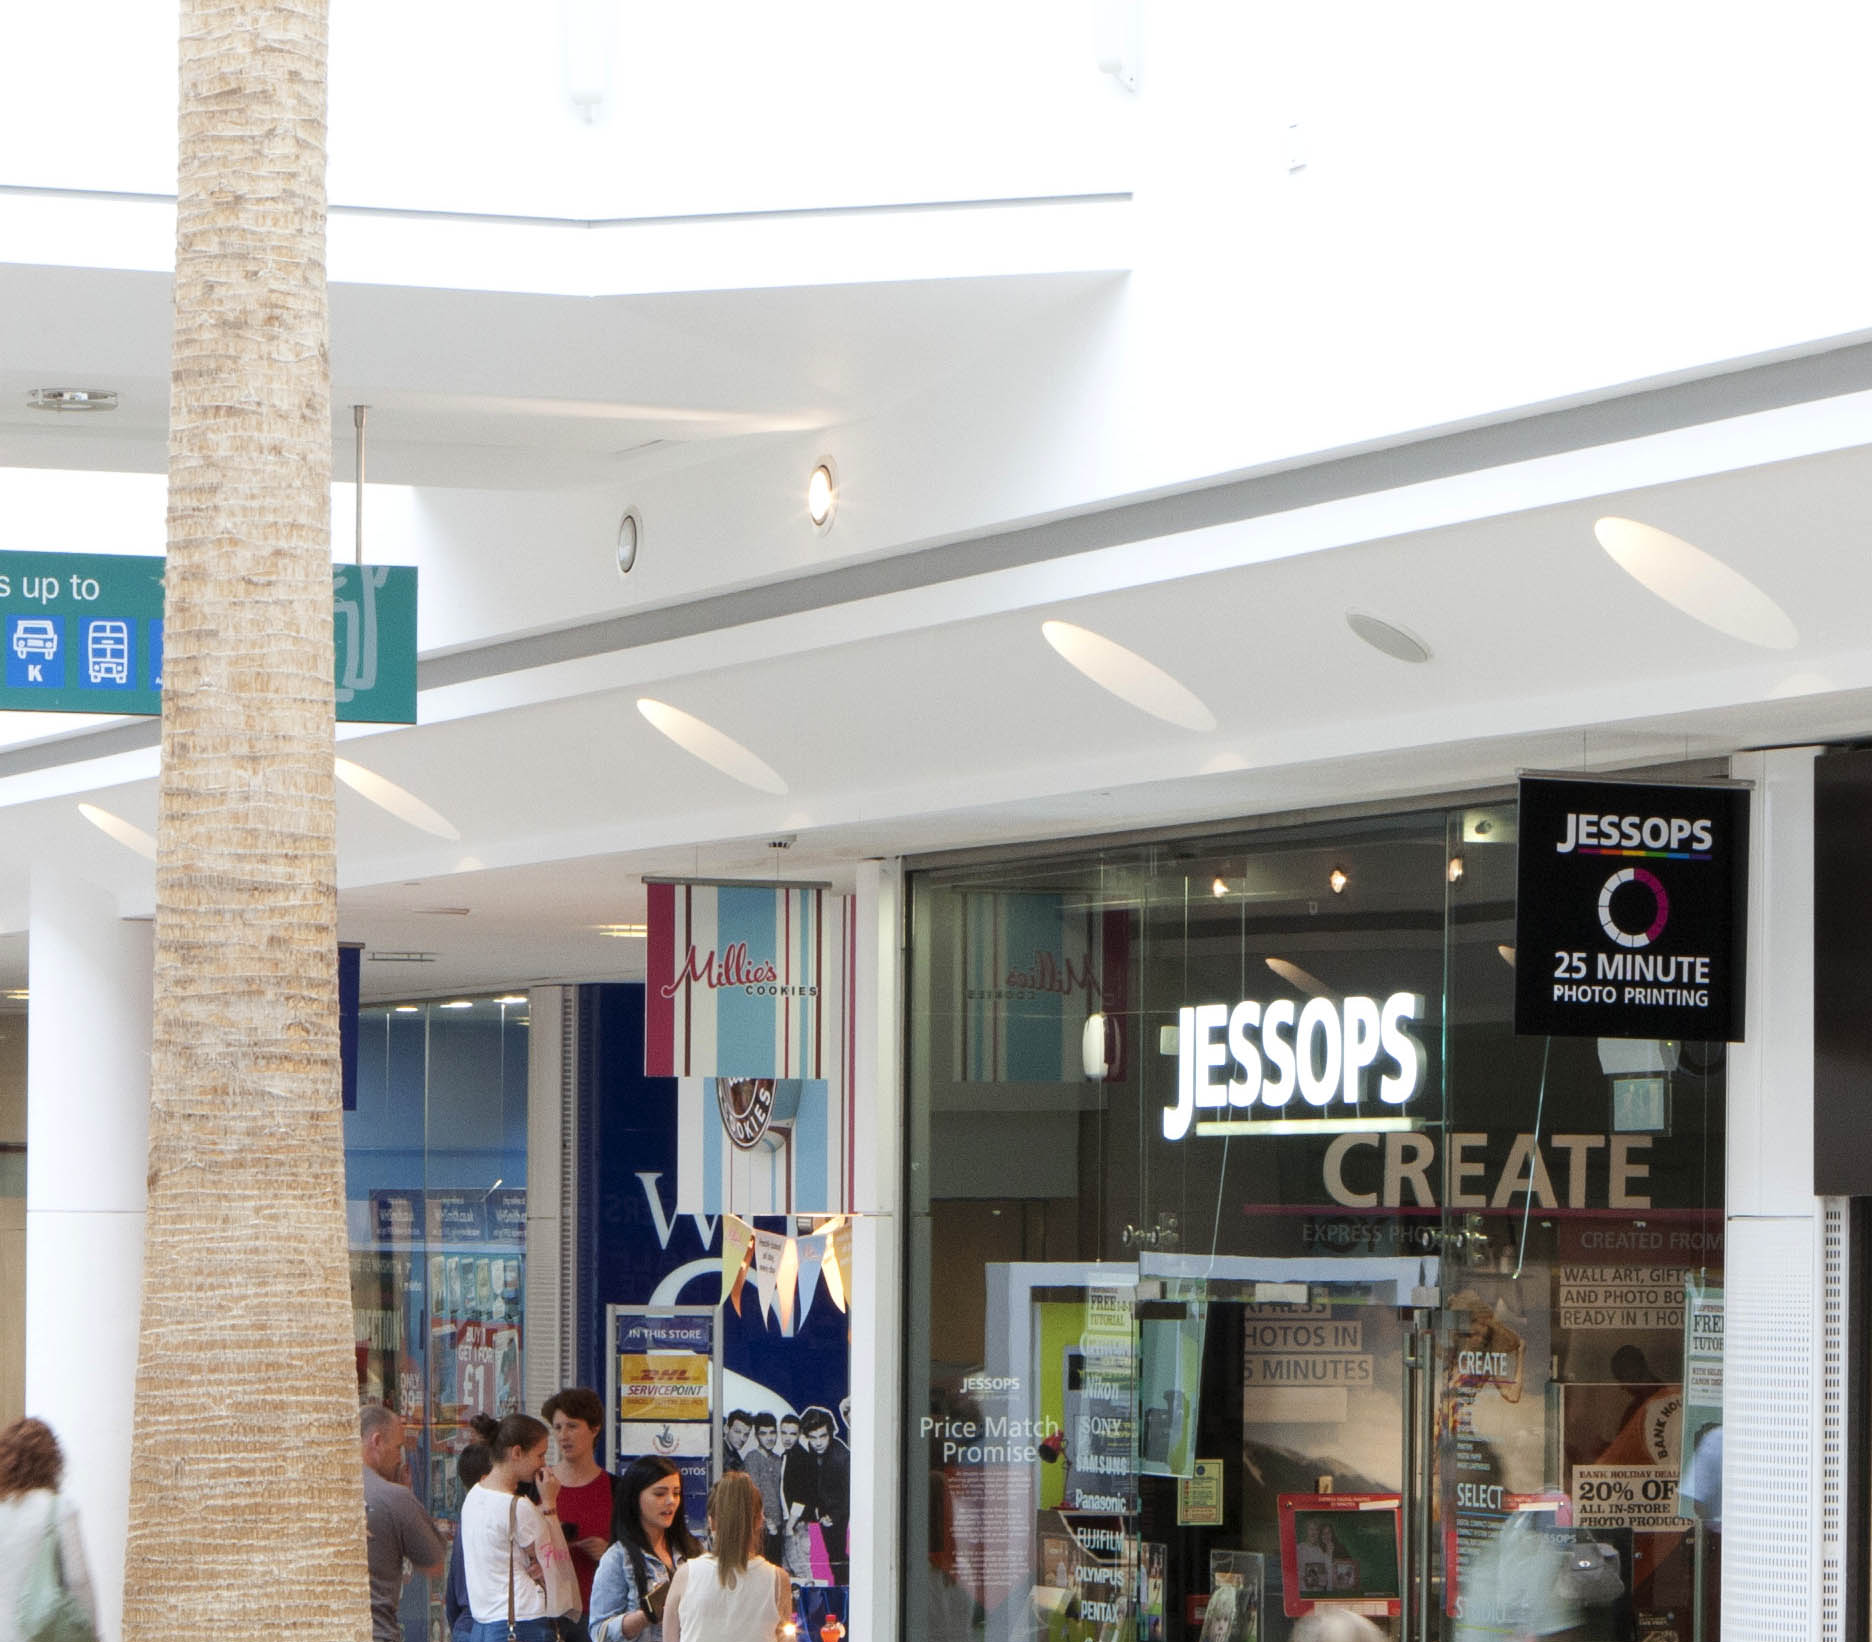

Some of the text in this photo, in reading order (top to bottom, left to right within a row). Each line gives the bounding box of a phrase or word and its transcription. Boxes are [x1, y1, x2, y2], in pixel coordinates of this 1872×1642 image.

[22, 575, 60, 605] up
[69, 573, 100, 601] to
[28, 663, 43, 682] K
[1556, 812, 1713, 854] JESSOPS
[661, 942, 778, 998] Millie's
[1553, 951, 1710, 984] 25 MINUTE
[745, 984, 818, 997] COOKIES
[1553, 985, 1709, 1008] PHOTO PRINTING
[1163, 992, 1424, 1141] JESSOPS
[1322, 1131, 1654, 1210] CREATE
[1302, 1224, 1383, 1243] EXPRESS
[1581, 1231, 1724, 1250] CREATED FROM
[1563, 1267, 1608, 1283] WALL
[1612, 1268, 1645, 1285] ART,
[1091, 1294, 1117, 1312] FREE
[1564, 1289, 1602, 1304] AND
[1604, 1290, 1659, 1305] PHOTO
[1563, 1311, 1616, 1326] READY
[1621, 1312, 1637, 1326] IN
[628, 1328, 702, 1340] IN THIS STORE
[1245, 1325, 1358, 1346] HOTOS IN
[1263, 1359, 1370, 1381] MINUTES
[1457, 1351, 1508, 1377] CREATE
[640, 1369, 690, 1381] DHL
[627, 1385, 704, 1396] SERVICEPOINT
[960, 1377, 1020, 1394] JESSOPS
[920, 1415, 1060, 1439] Price Match
[1081, 1416, 1122, 1435] SONY
[943, 1441, 1037, 1464] Promise
[1076, 1456, 1128, 1476] SAMSUNG
[1579, 1471, 1607, 1479] BANK
[1610, 1471, 1651, 1479] HOLIDAY
[1457, 1483, 1505, 1510] SELECT
[1579, 1479, 1680, 1501] 20% OF
[1076, 1488, 1127, 1513] Panasonic
[1580, 1503, 1671, 1514] ALL IN-STORE
[1579, 1516, 1695, 1527] PHOTO PRODUCTS
[1075, 1566, 1125, 1587] OLYMPUS
[1080, 1600, 1120, 1624] PENTAX
